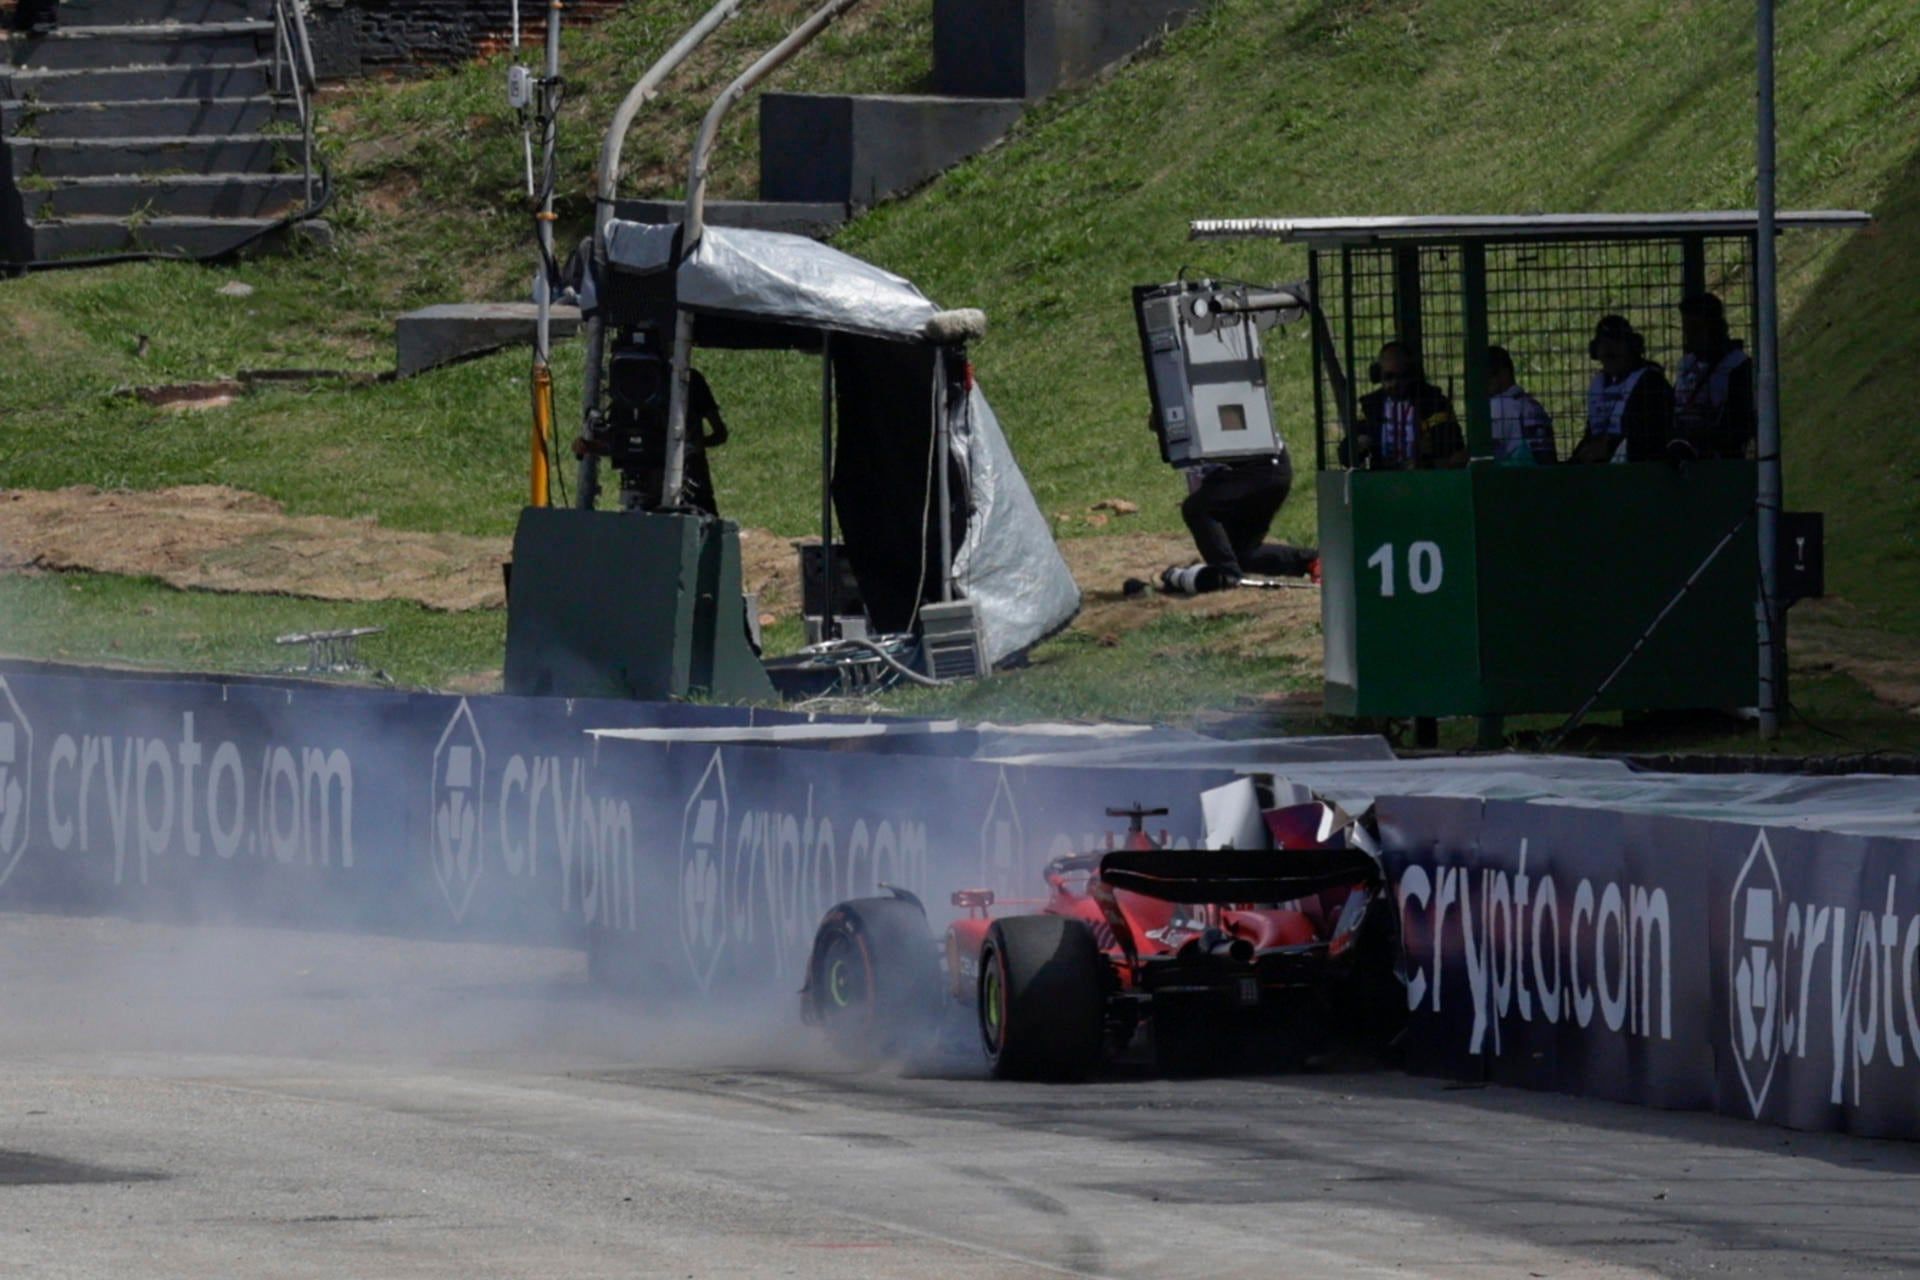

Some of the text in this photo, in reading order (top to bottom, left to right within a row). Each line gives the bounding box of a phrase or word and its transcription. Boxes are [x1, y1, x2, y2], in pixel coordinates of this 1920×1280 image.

[1366, 540, 1444, 597] 10
[733, 783, 928, 977] cryptocom
[1398, 837, 1671, 1056] crypto.com
